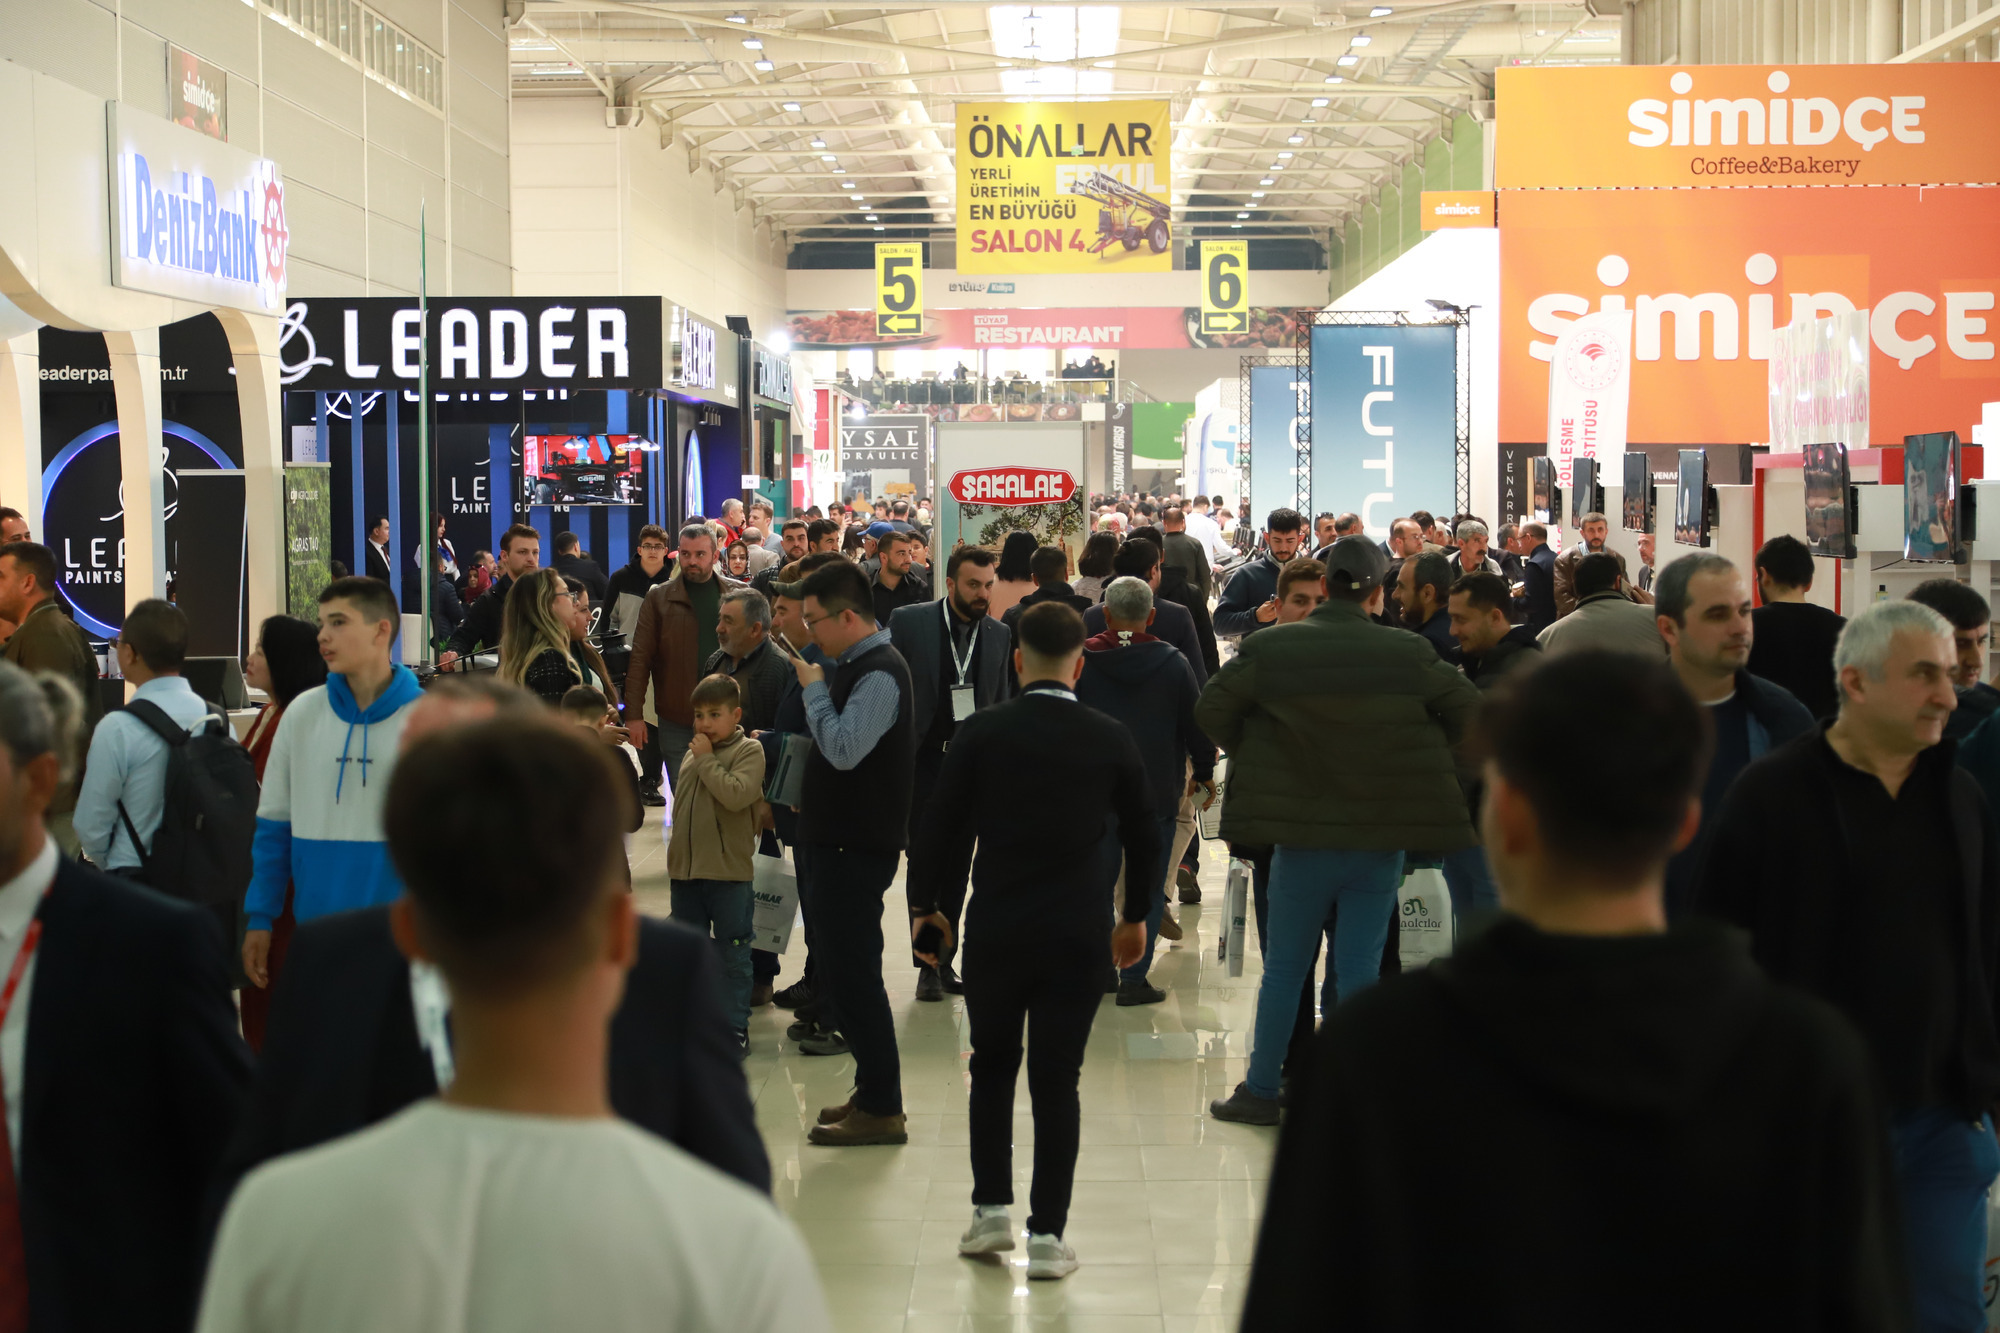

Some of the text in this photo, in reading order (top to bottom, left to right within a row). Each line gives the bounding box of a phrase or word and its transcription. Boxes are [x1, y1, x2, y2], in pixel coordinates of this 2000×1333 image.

[969, 115, 1153, 159] ÖNALLAR
[970, 164, 1011, 180] YERLİ
[1690, 156, 1861, 178] Coffee&Bakery
[970, 182, 1041, 198] ÜRETİMİN
[135, 153, 259, 283] DenizBank
[969, 199, 1076, 220] EN BÜYÜĞÜ
[970, 228, 1085, 253] SALON 4
[883, 257, 917, 312] 5
[1208, 253, 1241, 310] 6
[344, 307, 629, 379] LEADER
[974, 326, 1124, 343] RESTAURANT
[842, 430, 919, 446] YSAL
[1580, 400, 1598, 458] STİTÜSÜ
[1361, 345, 1394, 538] FUTU
[843, 451, 919, 460] DRAULIC
[961, 474, 1063, 501] ŞAKALAK
[453, 503, 490, 513] PAINT
[65, 570, 123, 584] PAINTS
